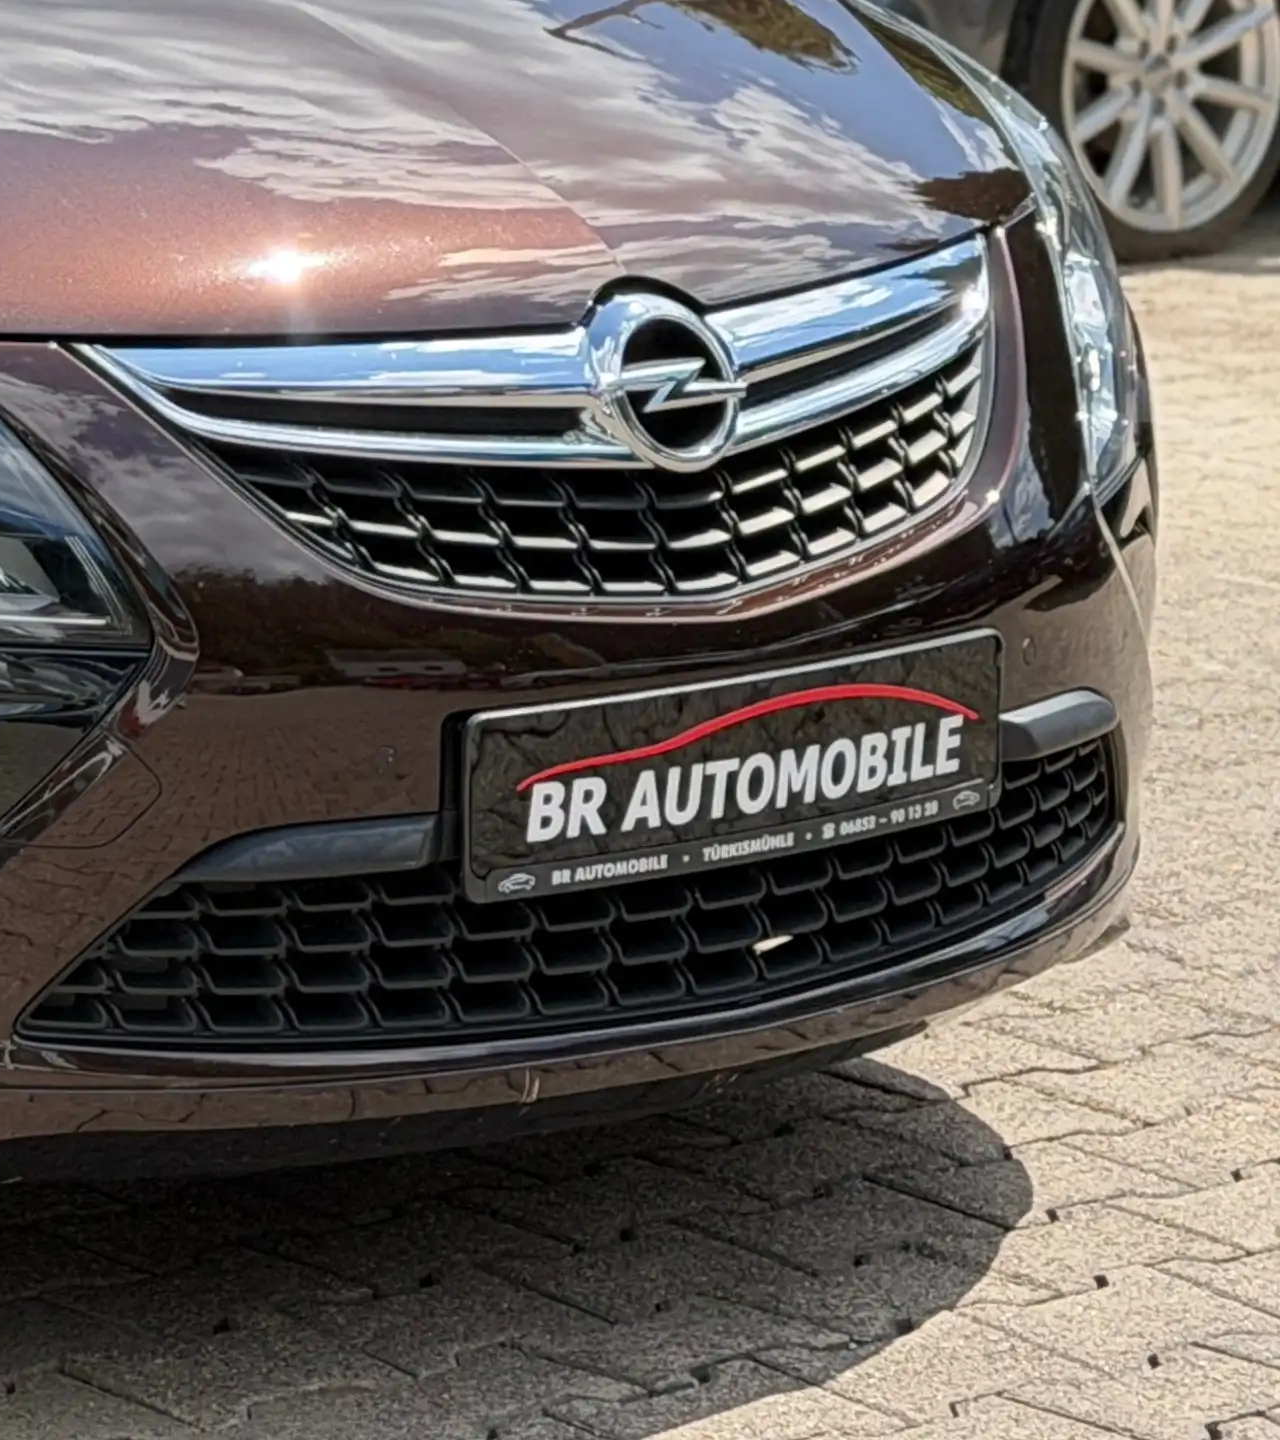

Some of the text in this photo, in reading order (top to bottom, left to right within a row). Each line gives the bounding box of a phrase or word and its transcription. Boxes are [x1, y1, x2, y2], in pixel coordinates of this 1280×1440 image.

[526, 715, 964, 843] BR AUTOMOBILE
[551, 868, 571, 886] BR
[573, 854, 669, 882] AUTOMOBILE
[908, 803, 922, 820] 13
